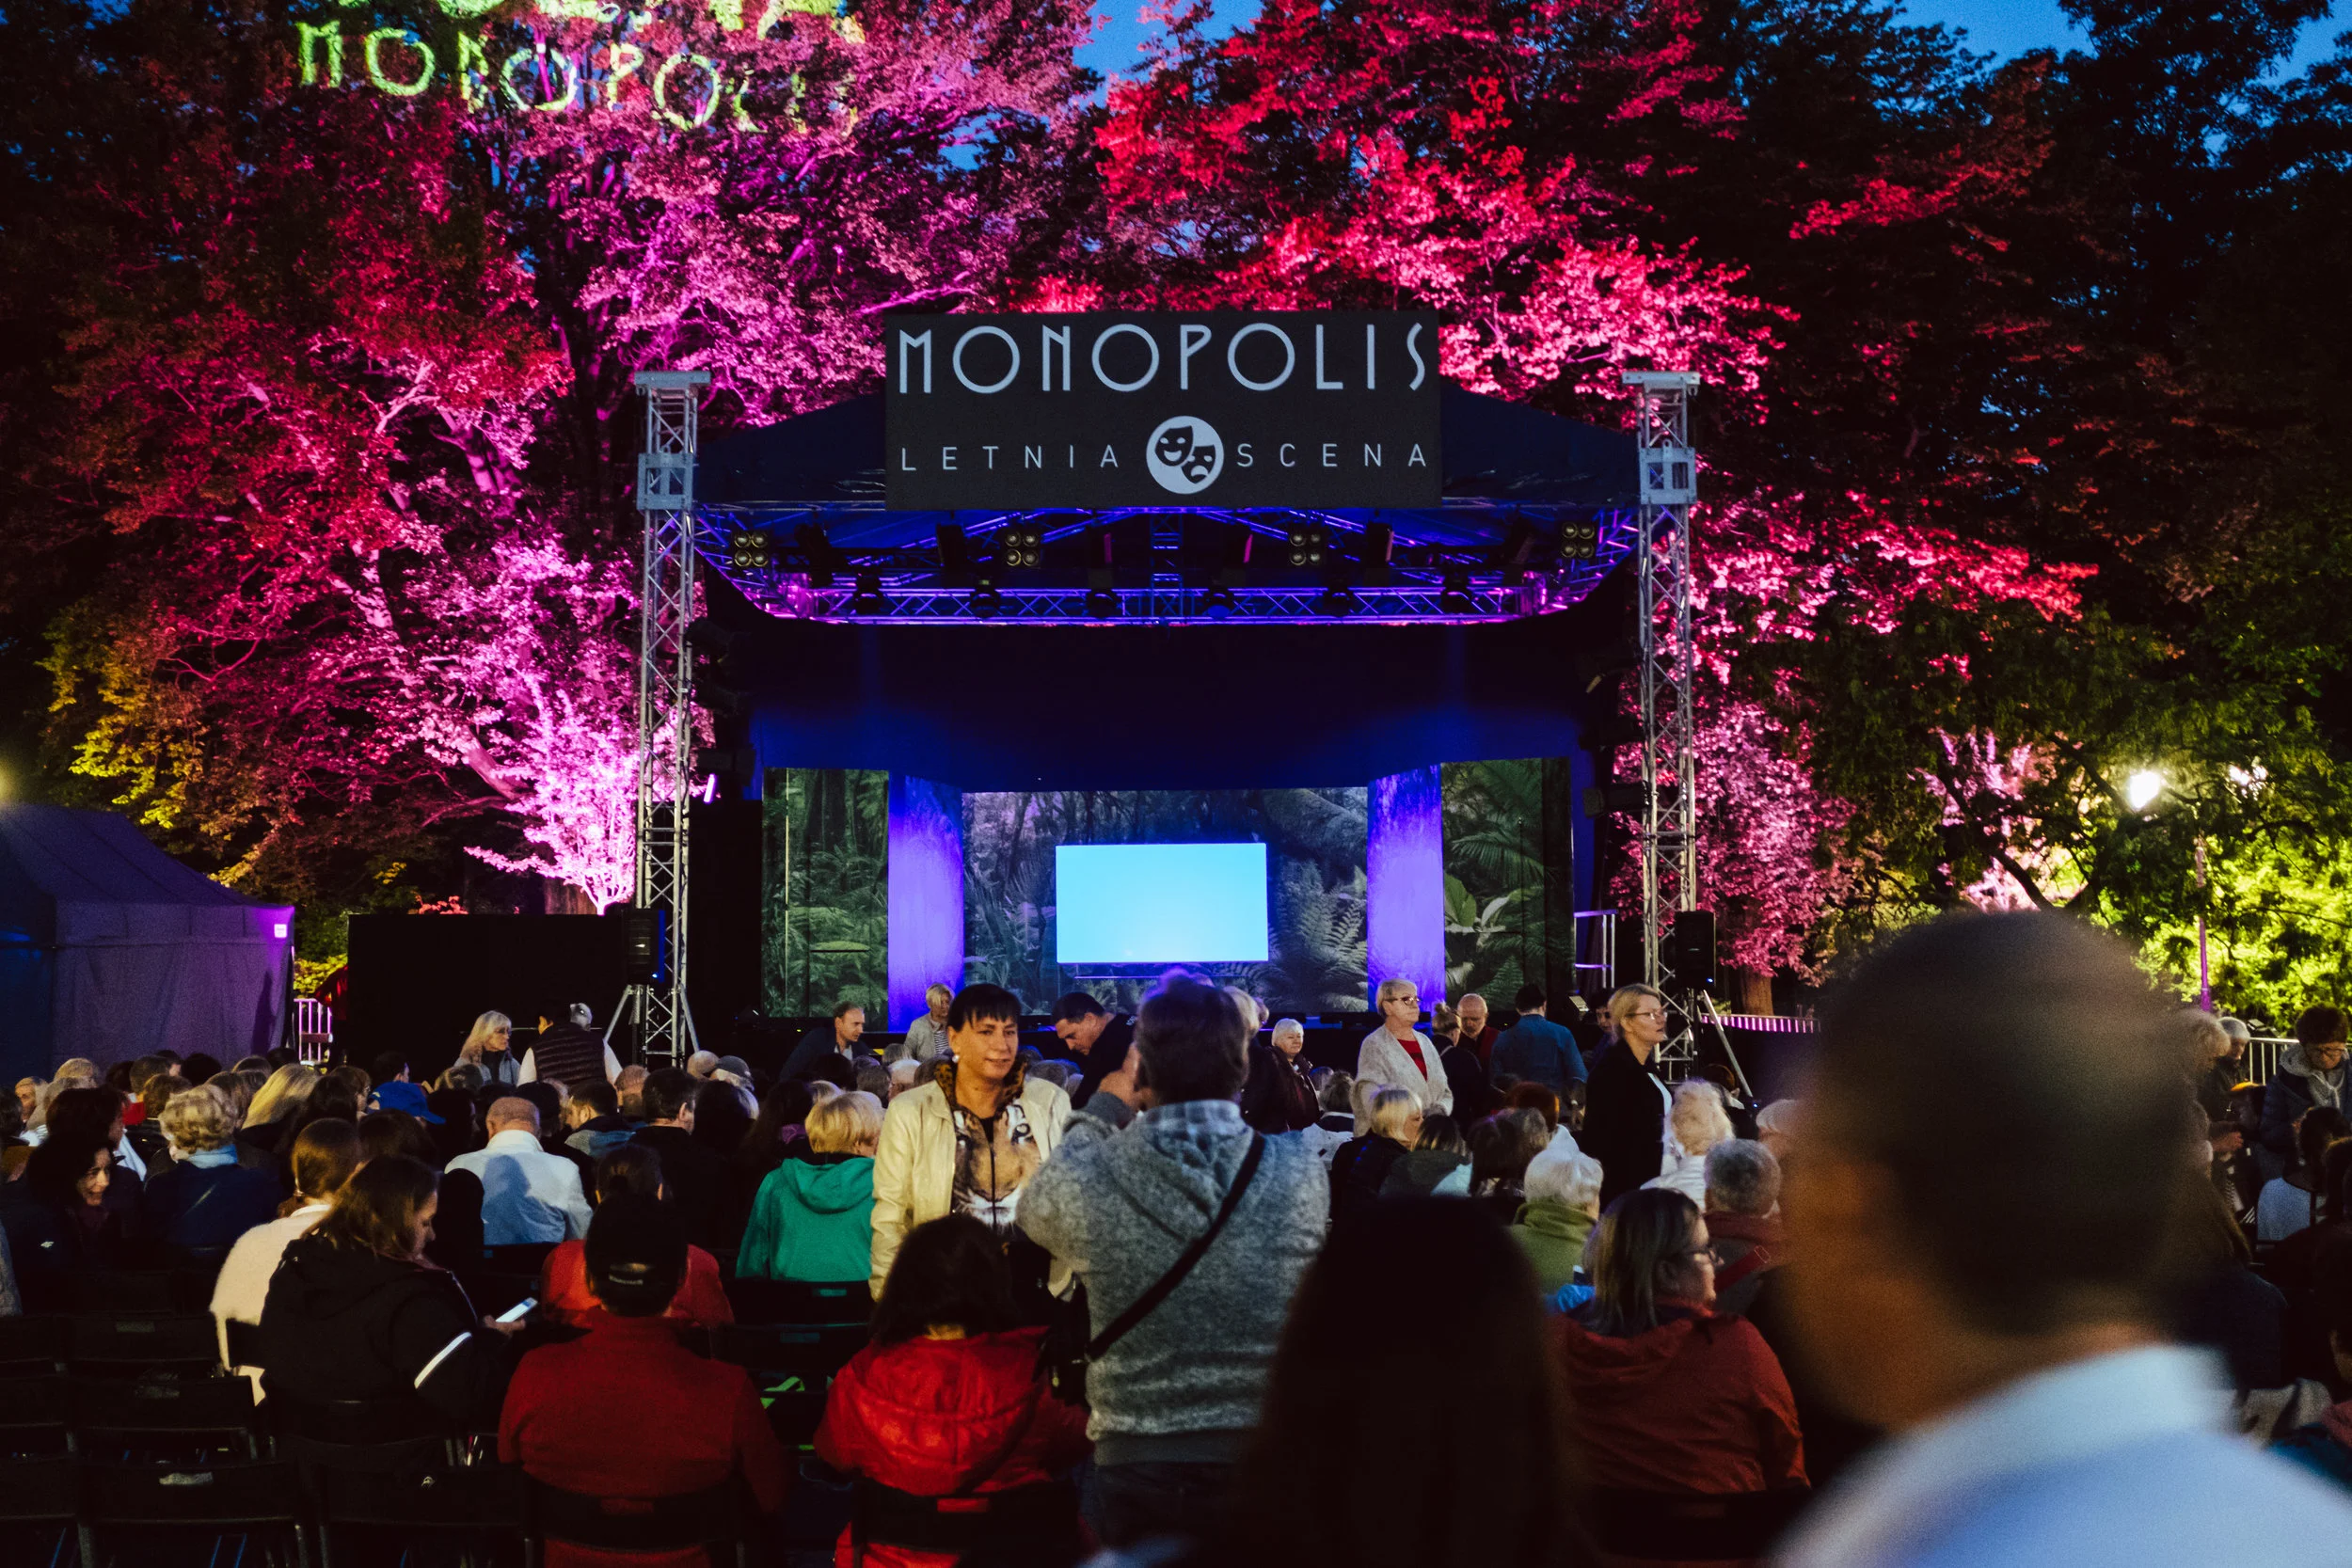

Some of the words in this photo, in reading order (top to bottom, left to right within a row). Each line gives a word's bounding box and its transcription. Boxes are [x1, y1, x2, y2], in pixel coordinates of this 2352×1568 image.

[899, 323, 1425, 393] MONOPOLIS
[901, 445, 1119, 470] LETNIA
[1236, 443, 1426, 467] SCENA
